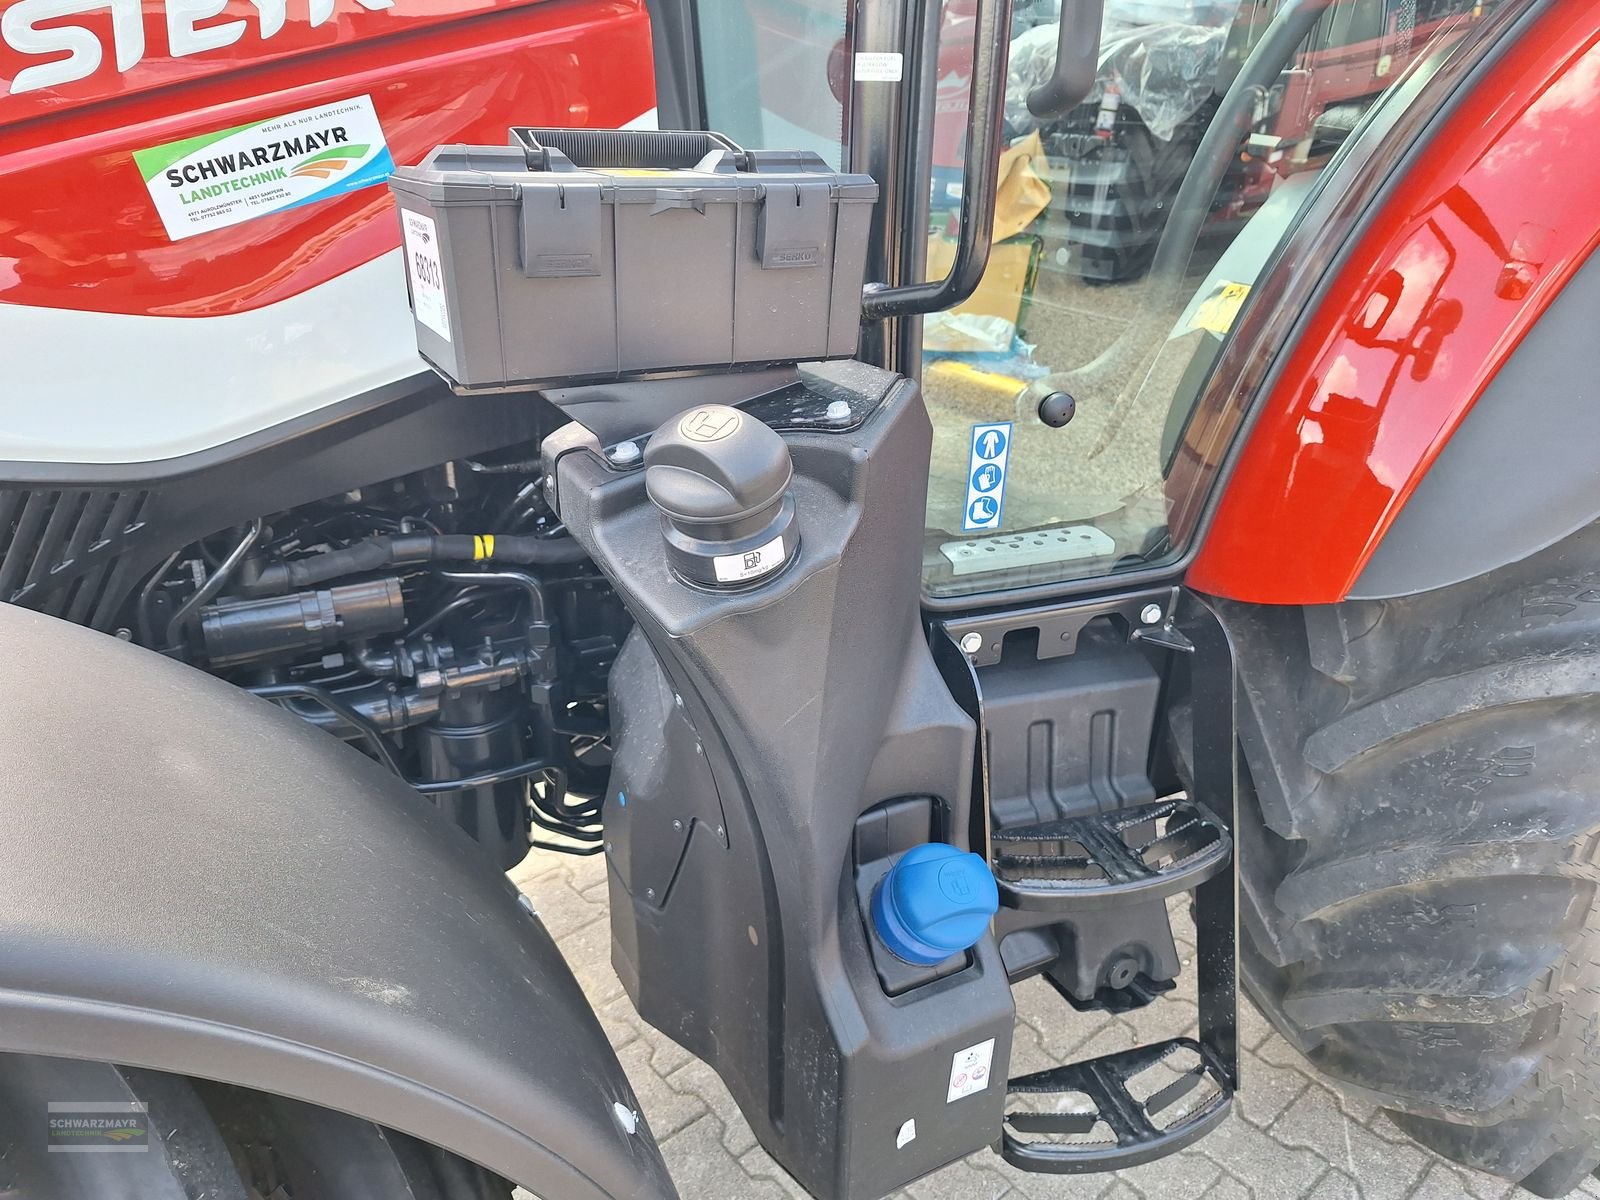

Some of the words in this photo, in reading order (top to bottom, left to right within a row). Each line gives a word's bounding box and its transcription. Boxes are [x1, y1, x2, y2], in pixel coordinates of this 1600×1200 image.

[262, 124, 281, 133] MEHR
[284, 120, 297, 128] ALS
[298, 117, 313, 125] NUR
[166, 126, 349, 188] SCHWARZMAYR
[179, 166, 288, 205] LANDTECHNIK
[415, 251, 440, 290] 68313
